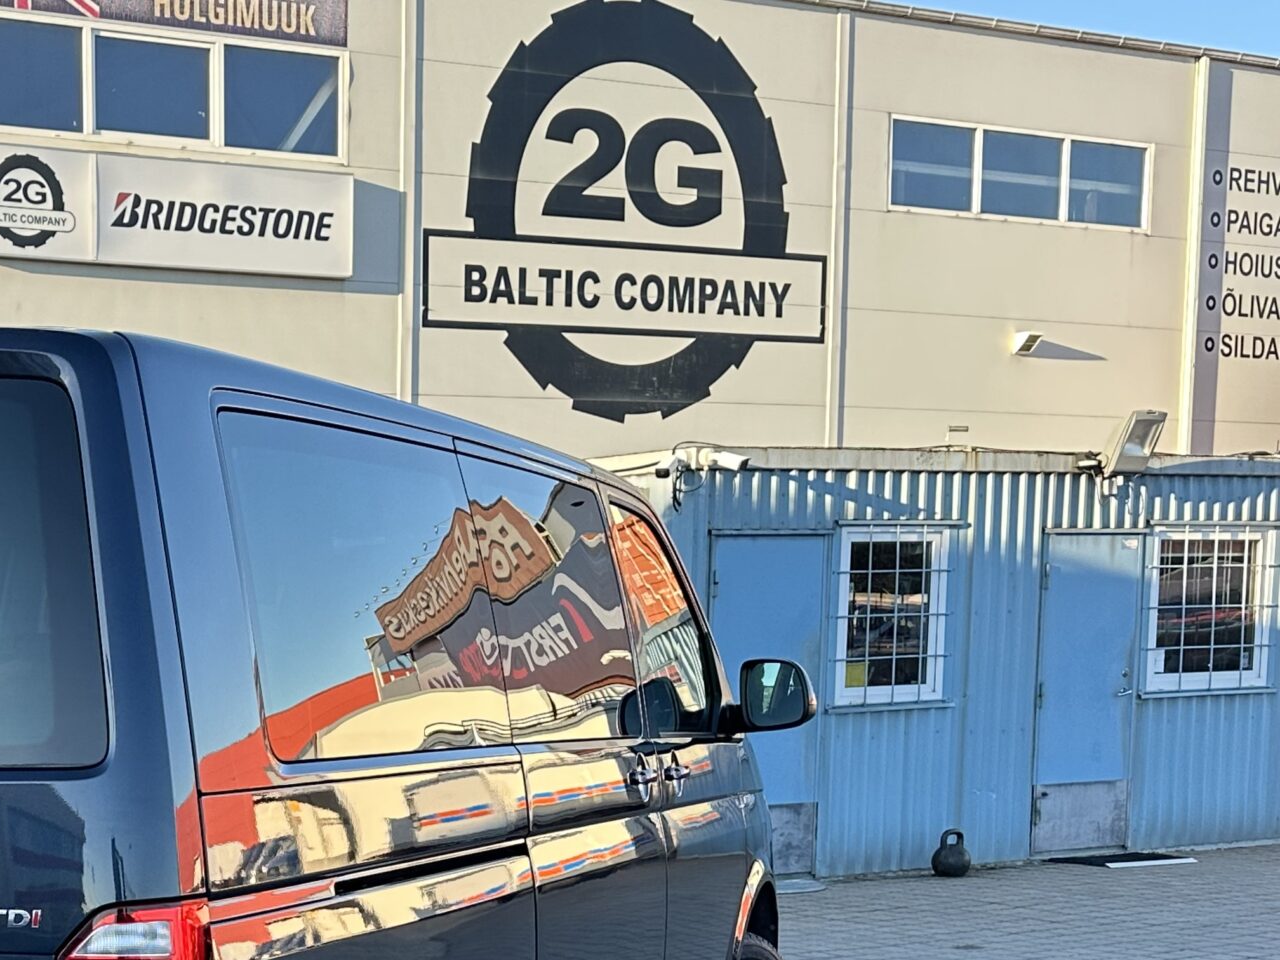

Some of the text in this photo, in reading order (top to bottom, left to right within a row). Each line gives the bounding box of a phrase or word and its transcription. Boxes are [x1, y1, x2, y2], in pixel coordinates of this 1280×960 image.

[541, 107, 724, 228] 2G
[2, 178, 47, 205] 2G
[19, 213, 68, 228] COMPANY
[110, 191, 334, 242] BRIDGESTONE
[464, 264, 792, 318] BALTIC COMPANY
[1222, 287, 1280, 320] ÕLIVA
[1220, 333, 1279, 360] SILDA
